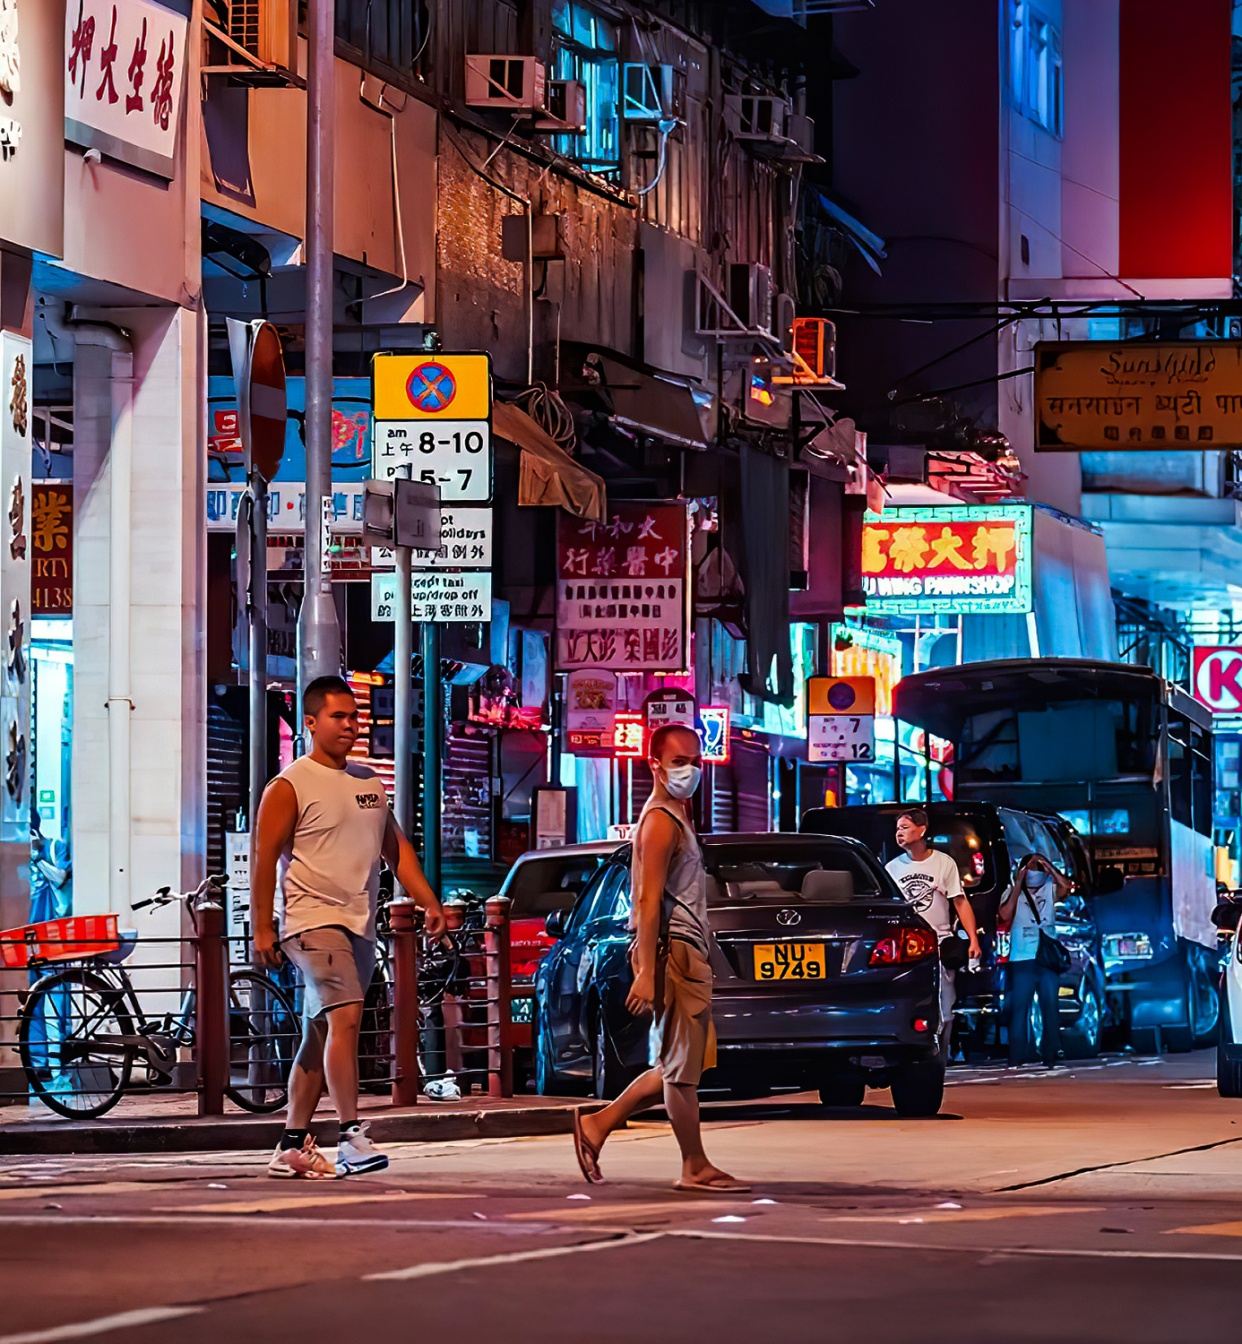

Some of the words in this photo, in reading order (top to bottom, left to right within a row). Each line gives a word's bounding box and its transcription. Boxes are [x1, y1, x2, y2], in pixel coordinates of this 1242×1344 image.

[387, 429, 407, 438] am
[381, 442, 413, 457] 上午
[419, 431, 484, 454] 8-10
[440, 528, 486, 540] olidays
[862, 576, 876, 595] U
[461, 589, 479, 600] off
[1209, 657, 1242, 703] K
[849, 718, 861, 734] 7
[851, 743, 871, 759] 12
[774, 944, 805, 964] NU
[760, 961, 820, 980] 9749
